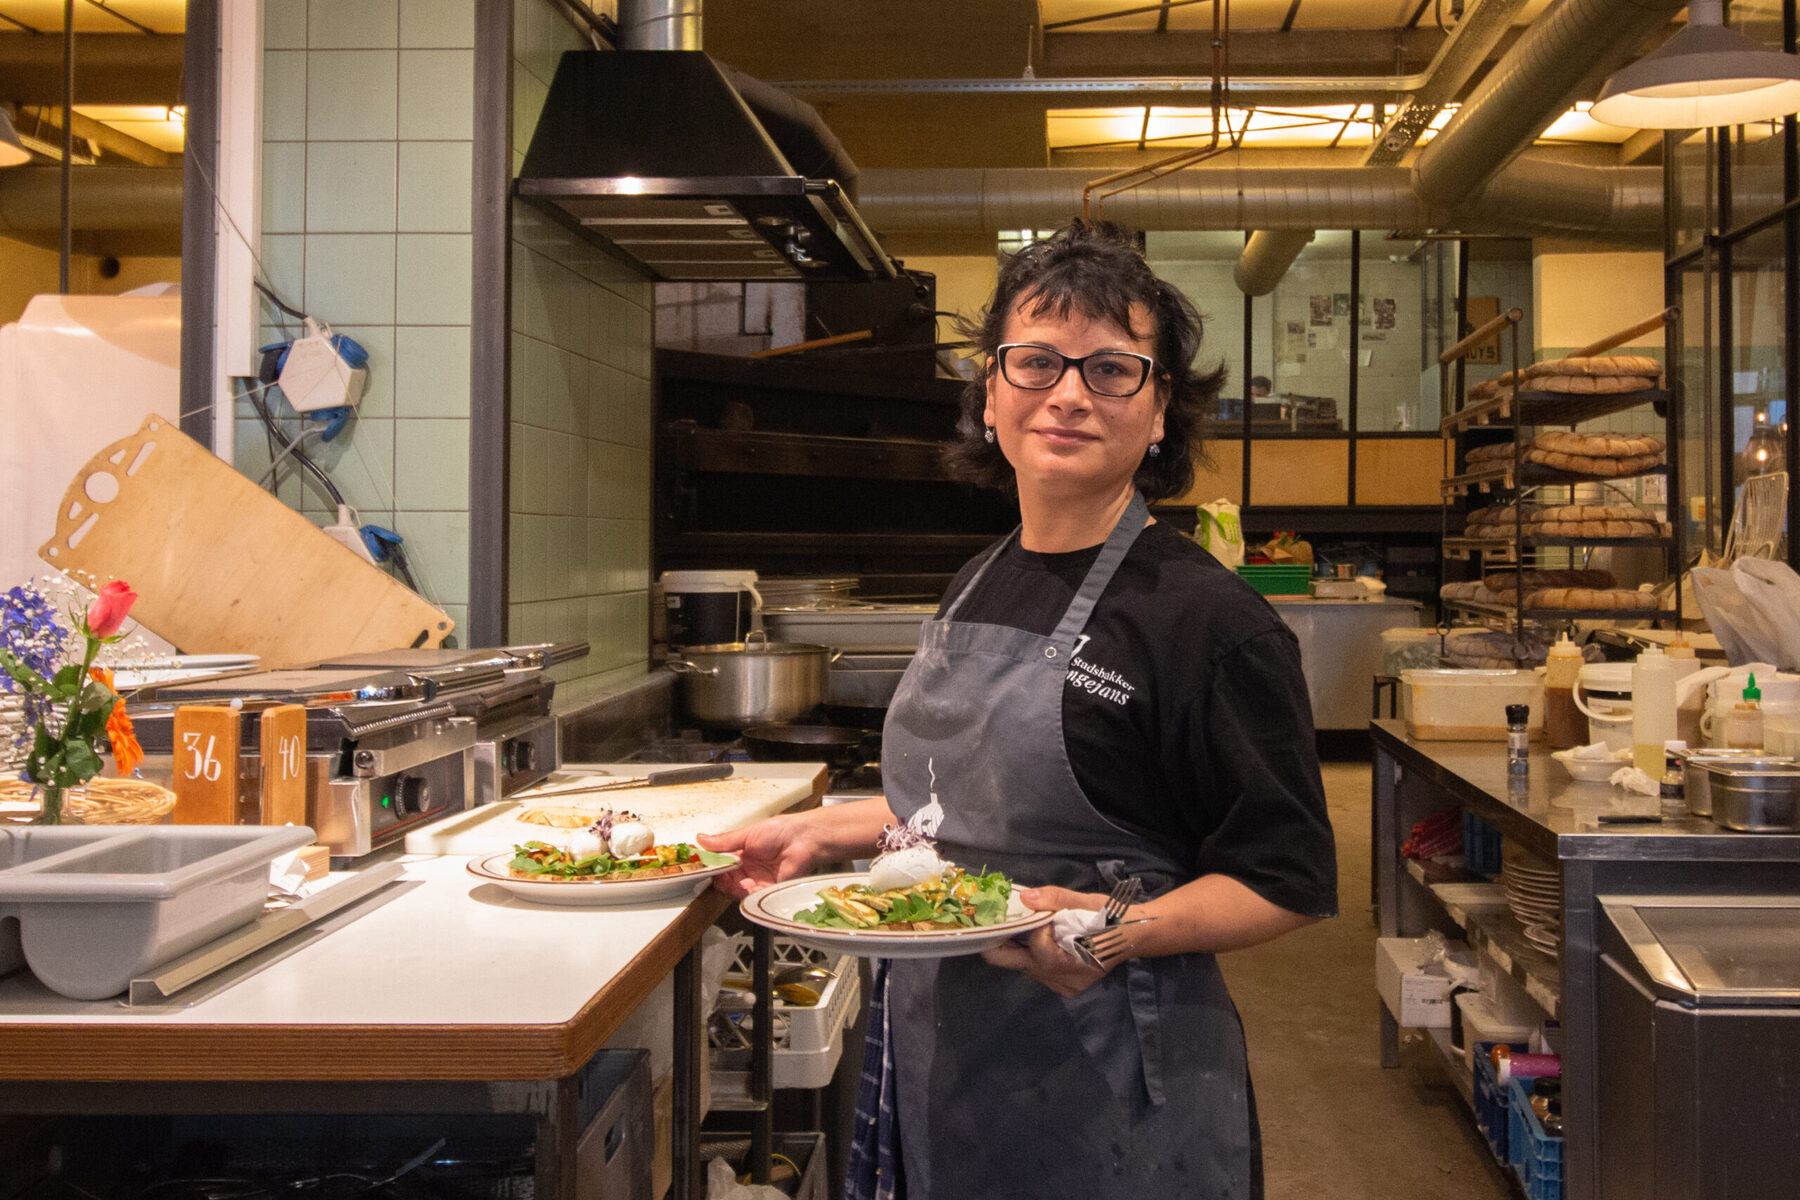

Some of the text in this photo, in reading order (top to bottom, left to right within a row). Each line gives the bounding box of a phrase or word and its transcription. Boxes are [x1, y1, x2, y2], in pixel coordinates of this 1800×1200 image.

[1066, 670, 1130, 705] ngejans
[1071, 656, 1135, 692] Stadsbakker
[183, 732, 221, 782] 36
[278, 735, 300, 780] 40
